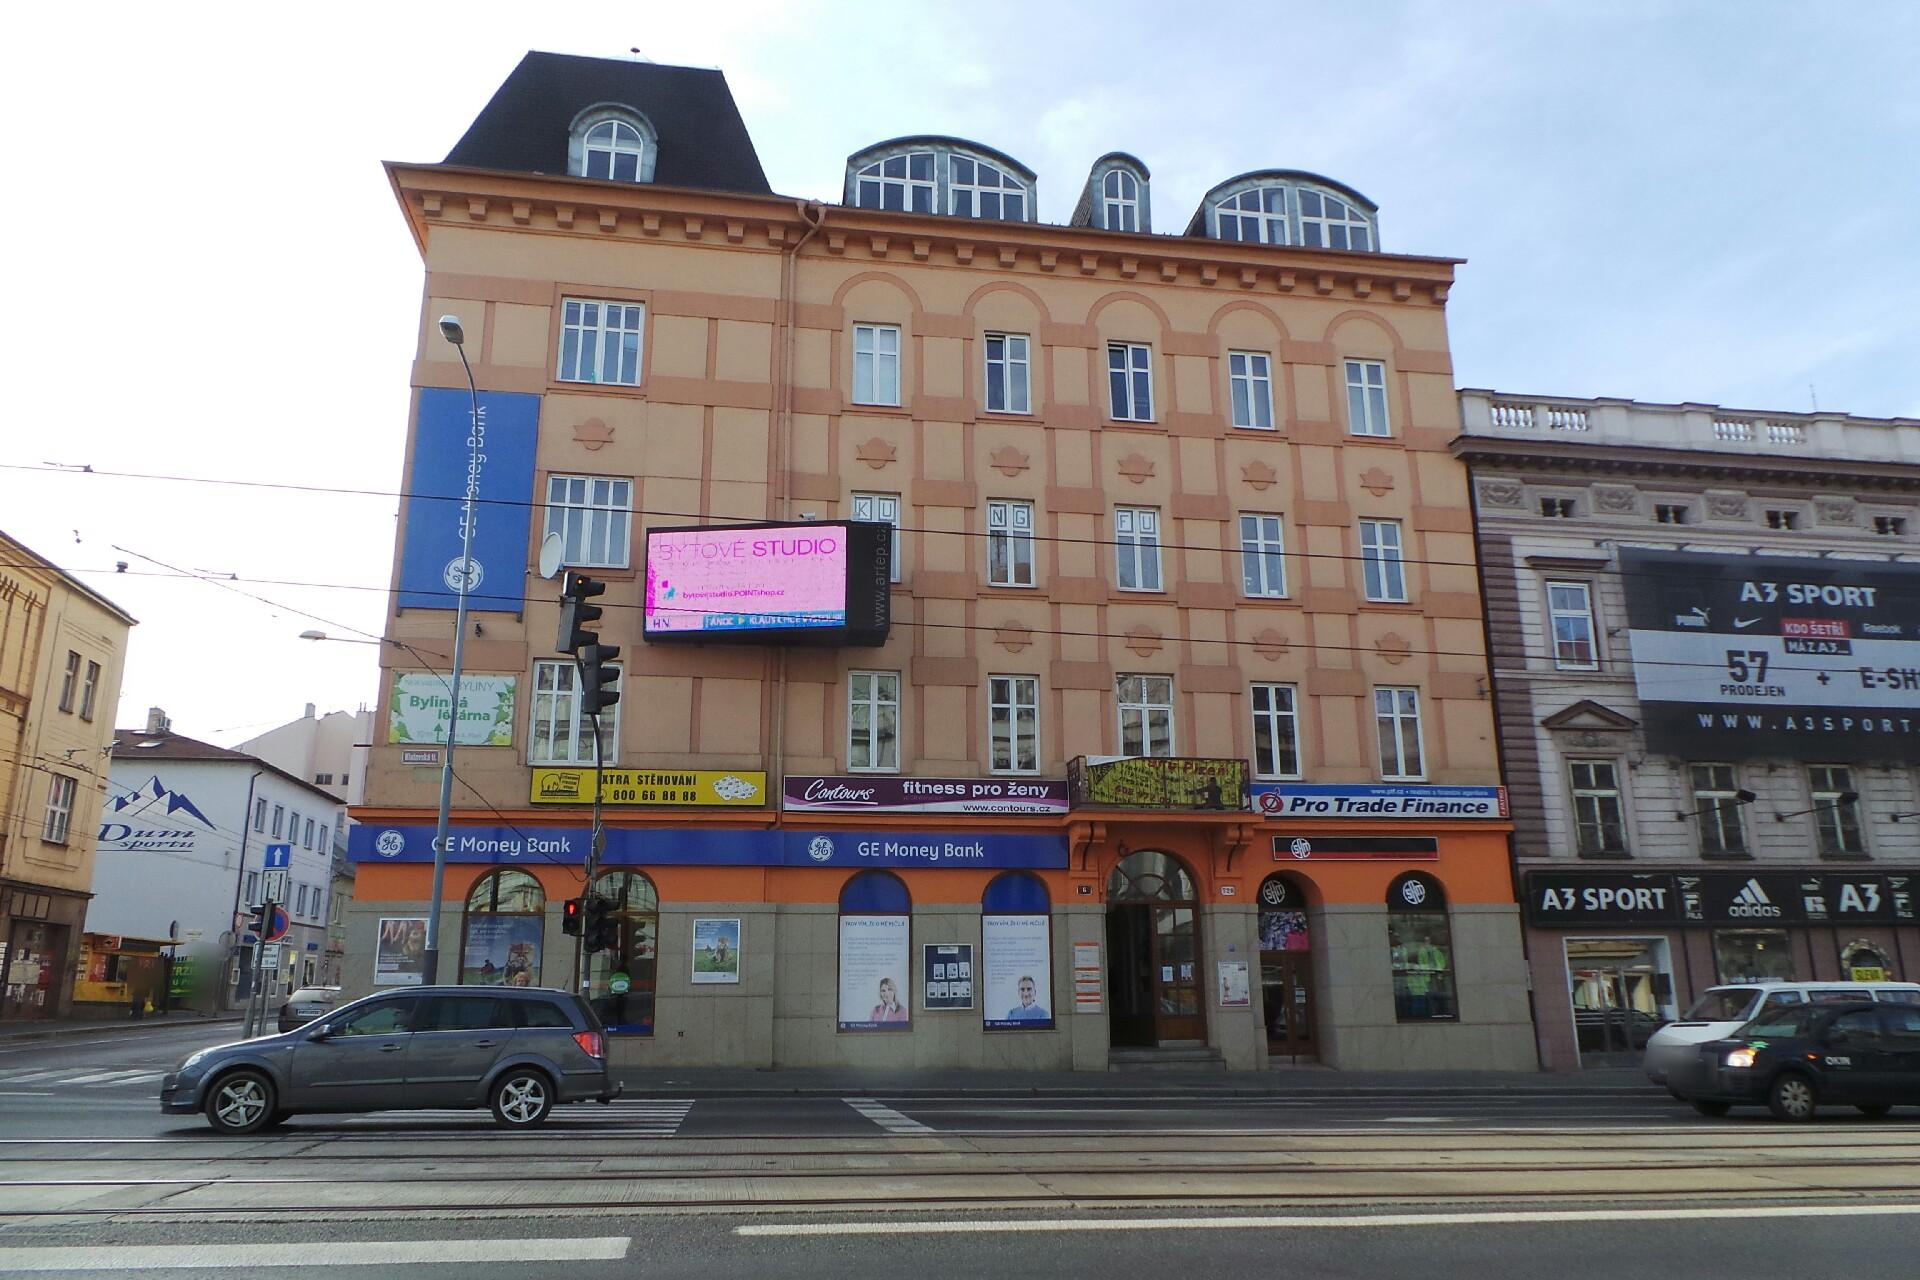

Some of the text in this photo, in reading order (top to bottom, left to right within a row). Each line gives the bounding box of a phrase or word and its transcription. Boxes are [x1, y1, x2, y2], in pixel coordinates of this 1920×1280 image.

[467, 406, 487, 448] Bank
[752, 537, 837, 558] STUDIO
[1740, 581, 1877, 608] A3 SPORT
[1785, 620, 1845, 636] KDO ŠETŘÍ
[1726, 649, 1769, 683] 57
[1720, 683, 1786, 697] PRODEJEN
[409, 695, 468, 710] Byliná
[438, 708, 491, 721] léárna
[600, 773, 697, 786] XTRA STĚHOVÁNÍ
[612, 789, 697, 801] 800 66 88 88
[804, 778, 876, 802] Contours
[903, 781, 1049, 798] fitness pro ženy
[963, 804, 1051, 814] www.contours.cz
[1289, 797, 1489, 814] Pro Trade Finance
[120, 839, 195, 850] sportu
[460, 836, 521, 856] Money
[527, 837, 571, 854] Bank
[857, 842, 984, 860] GE Money Bank
[1542, 888, 1667, 911] A3 SPORT
[1839, 884, 1881, 913] A3
[1728, 903, 1782, 917] adidas
